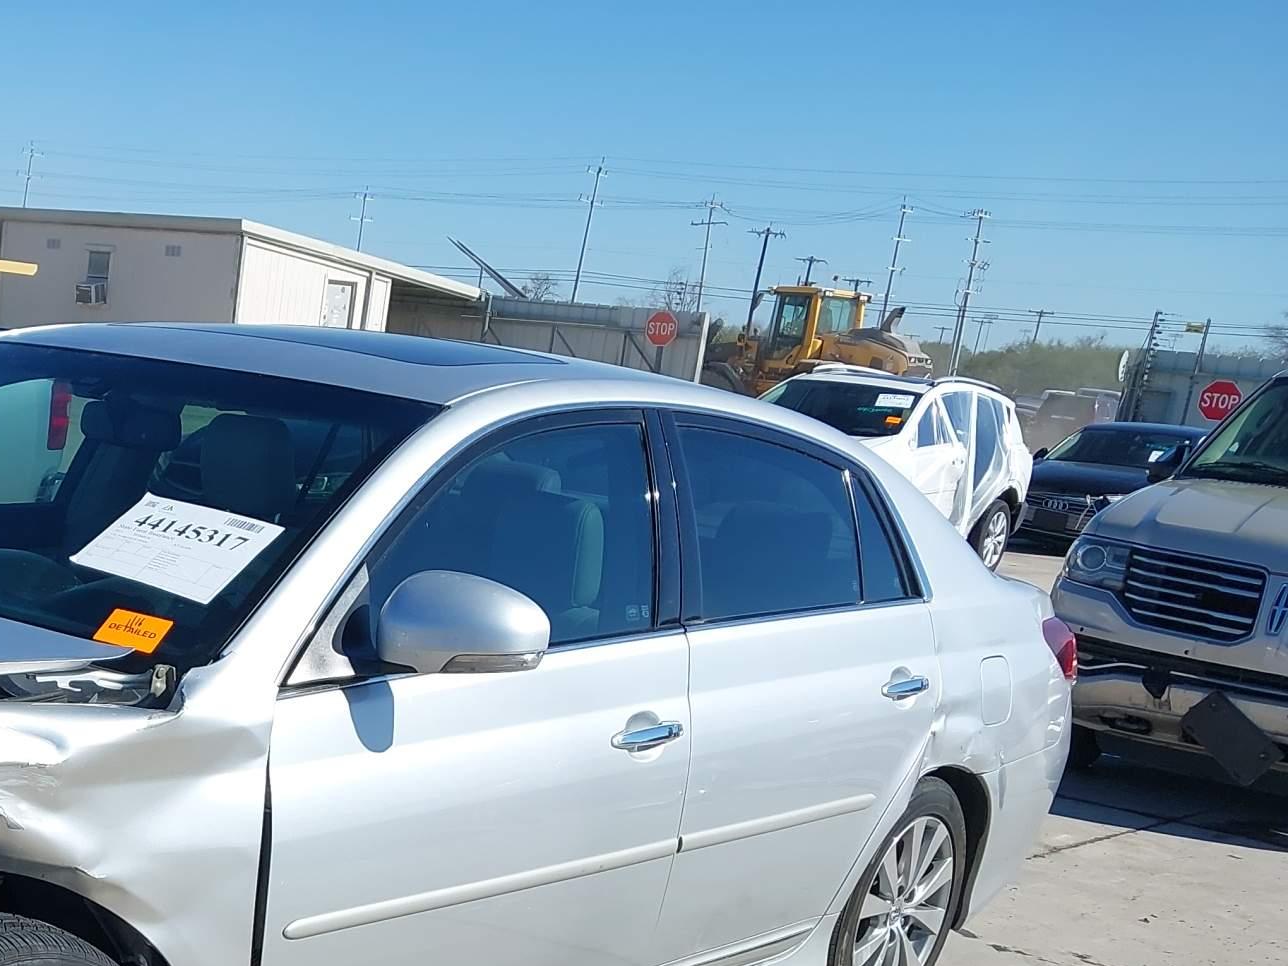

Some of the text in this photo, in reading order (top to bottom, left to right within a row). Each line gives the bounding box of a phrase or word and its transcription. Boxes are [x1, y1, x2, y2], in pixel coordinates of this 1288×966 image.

[647, 321, 675, 336] STOP
[1200, 392, 1239, 410] STOP
[134, 514, 250, 551] 44145317
[108, 622, 157, 639] DETAILED
